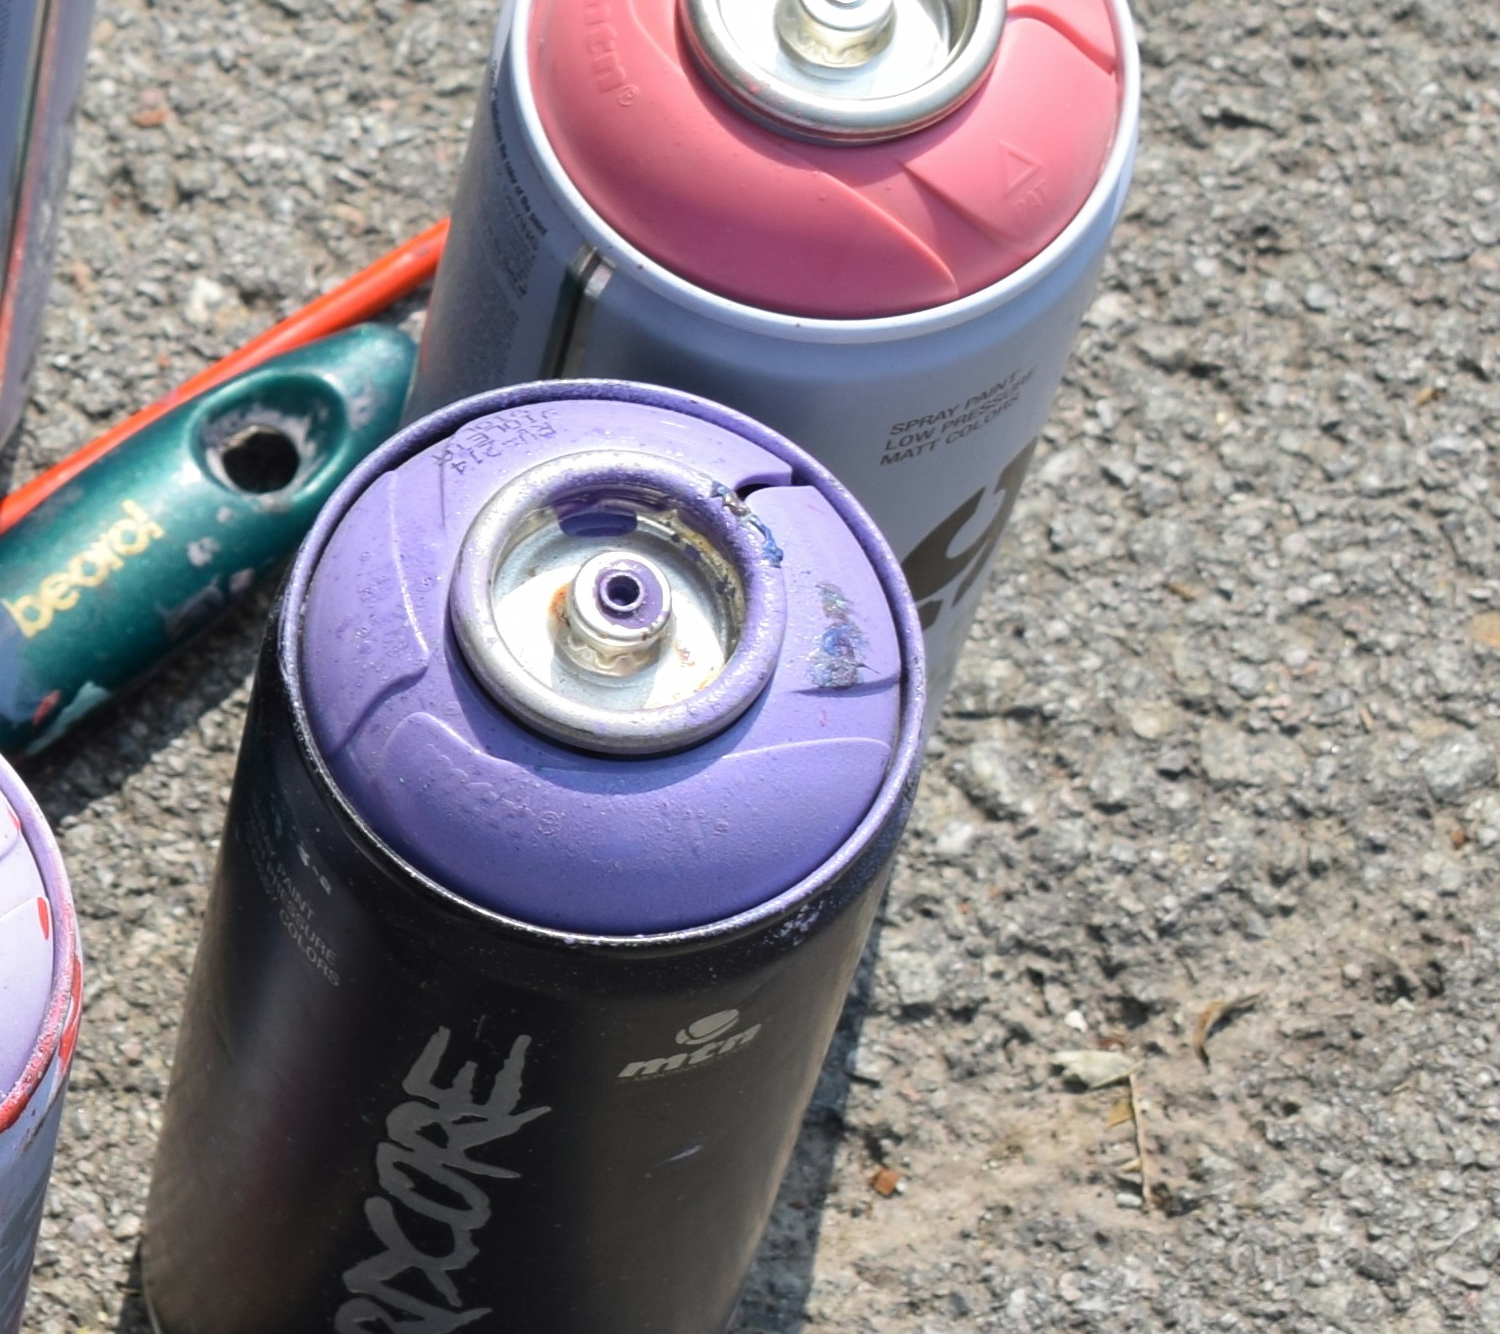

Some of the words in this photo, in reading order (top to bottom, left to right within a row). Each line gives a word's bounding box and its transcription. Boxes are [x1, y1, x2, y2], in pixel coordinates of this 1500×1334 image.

[889, 403, 961, 436] SPRAY
[964, 367, 1022, 410] PAINT
[879, 437, 941, 466] MATT
[884, 426, 936, 451] LOW
[279, 907, 340, 988] COLORS
[616, 1023, 763, 1080] mtn
